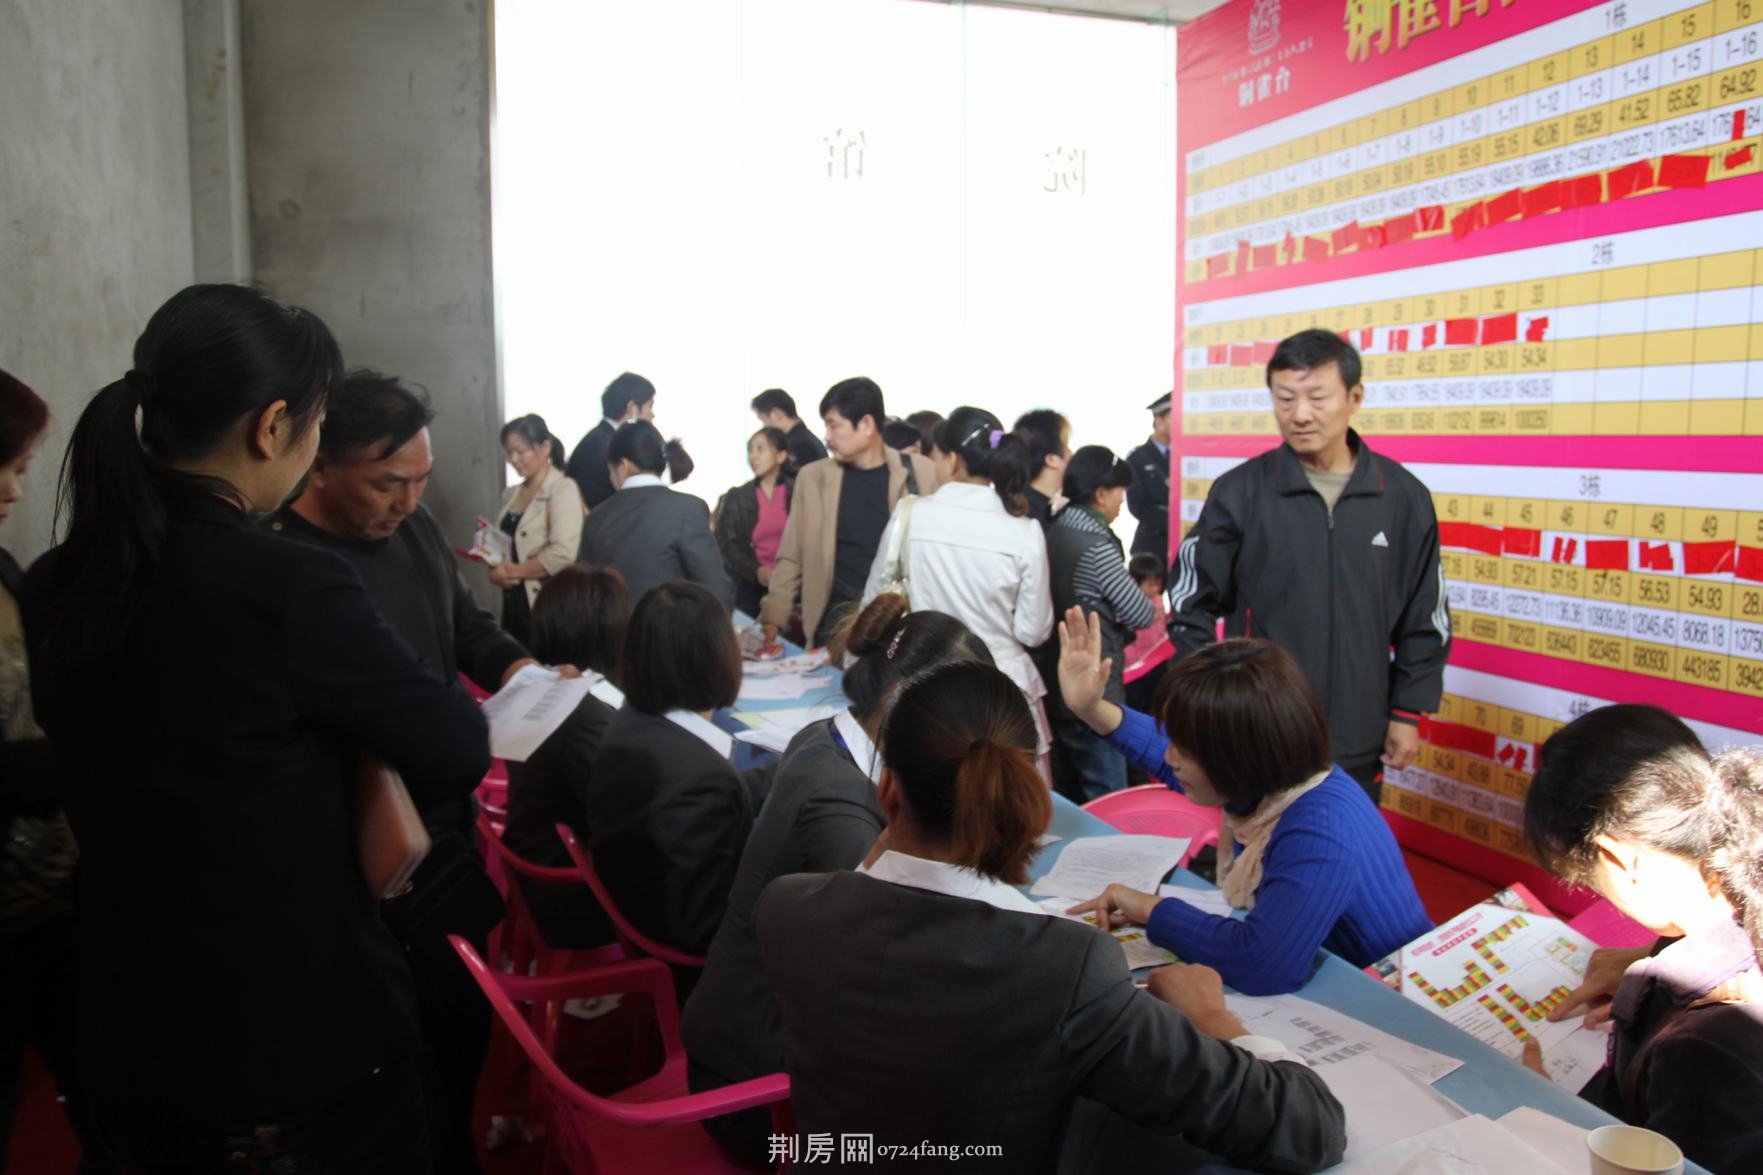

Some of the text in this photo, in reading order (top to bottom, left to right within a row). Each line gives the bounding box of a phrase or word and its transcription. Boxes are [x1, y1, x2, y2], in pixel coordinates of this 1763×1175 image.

[1632, 31, 1645, 54] 14
[1682, 14, 1697, 38] 15
[1736, 0, 1752, 21] 16
[1672, 48, 1702, 76] 1-15
[1726, 31, 1757, 60] 1-16
[1720, 68, 1757, 99] 64.92
[1603, 509, 1618, 529] 47
[1650, 512, 1666, 534] 48
[1701, 515, 1719, 538] 49
[1688, 585, 1723, 611] 54.93
[1682, 618, 1725, 648] 8068.18
[1682, 654, 1721, 683] 443185
